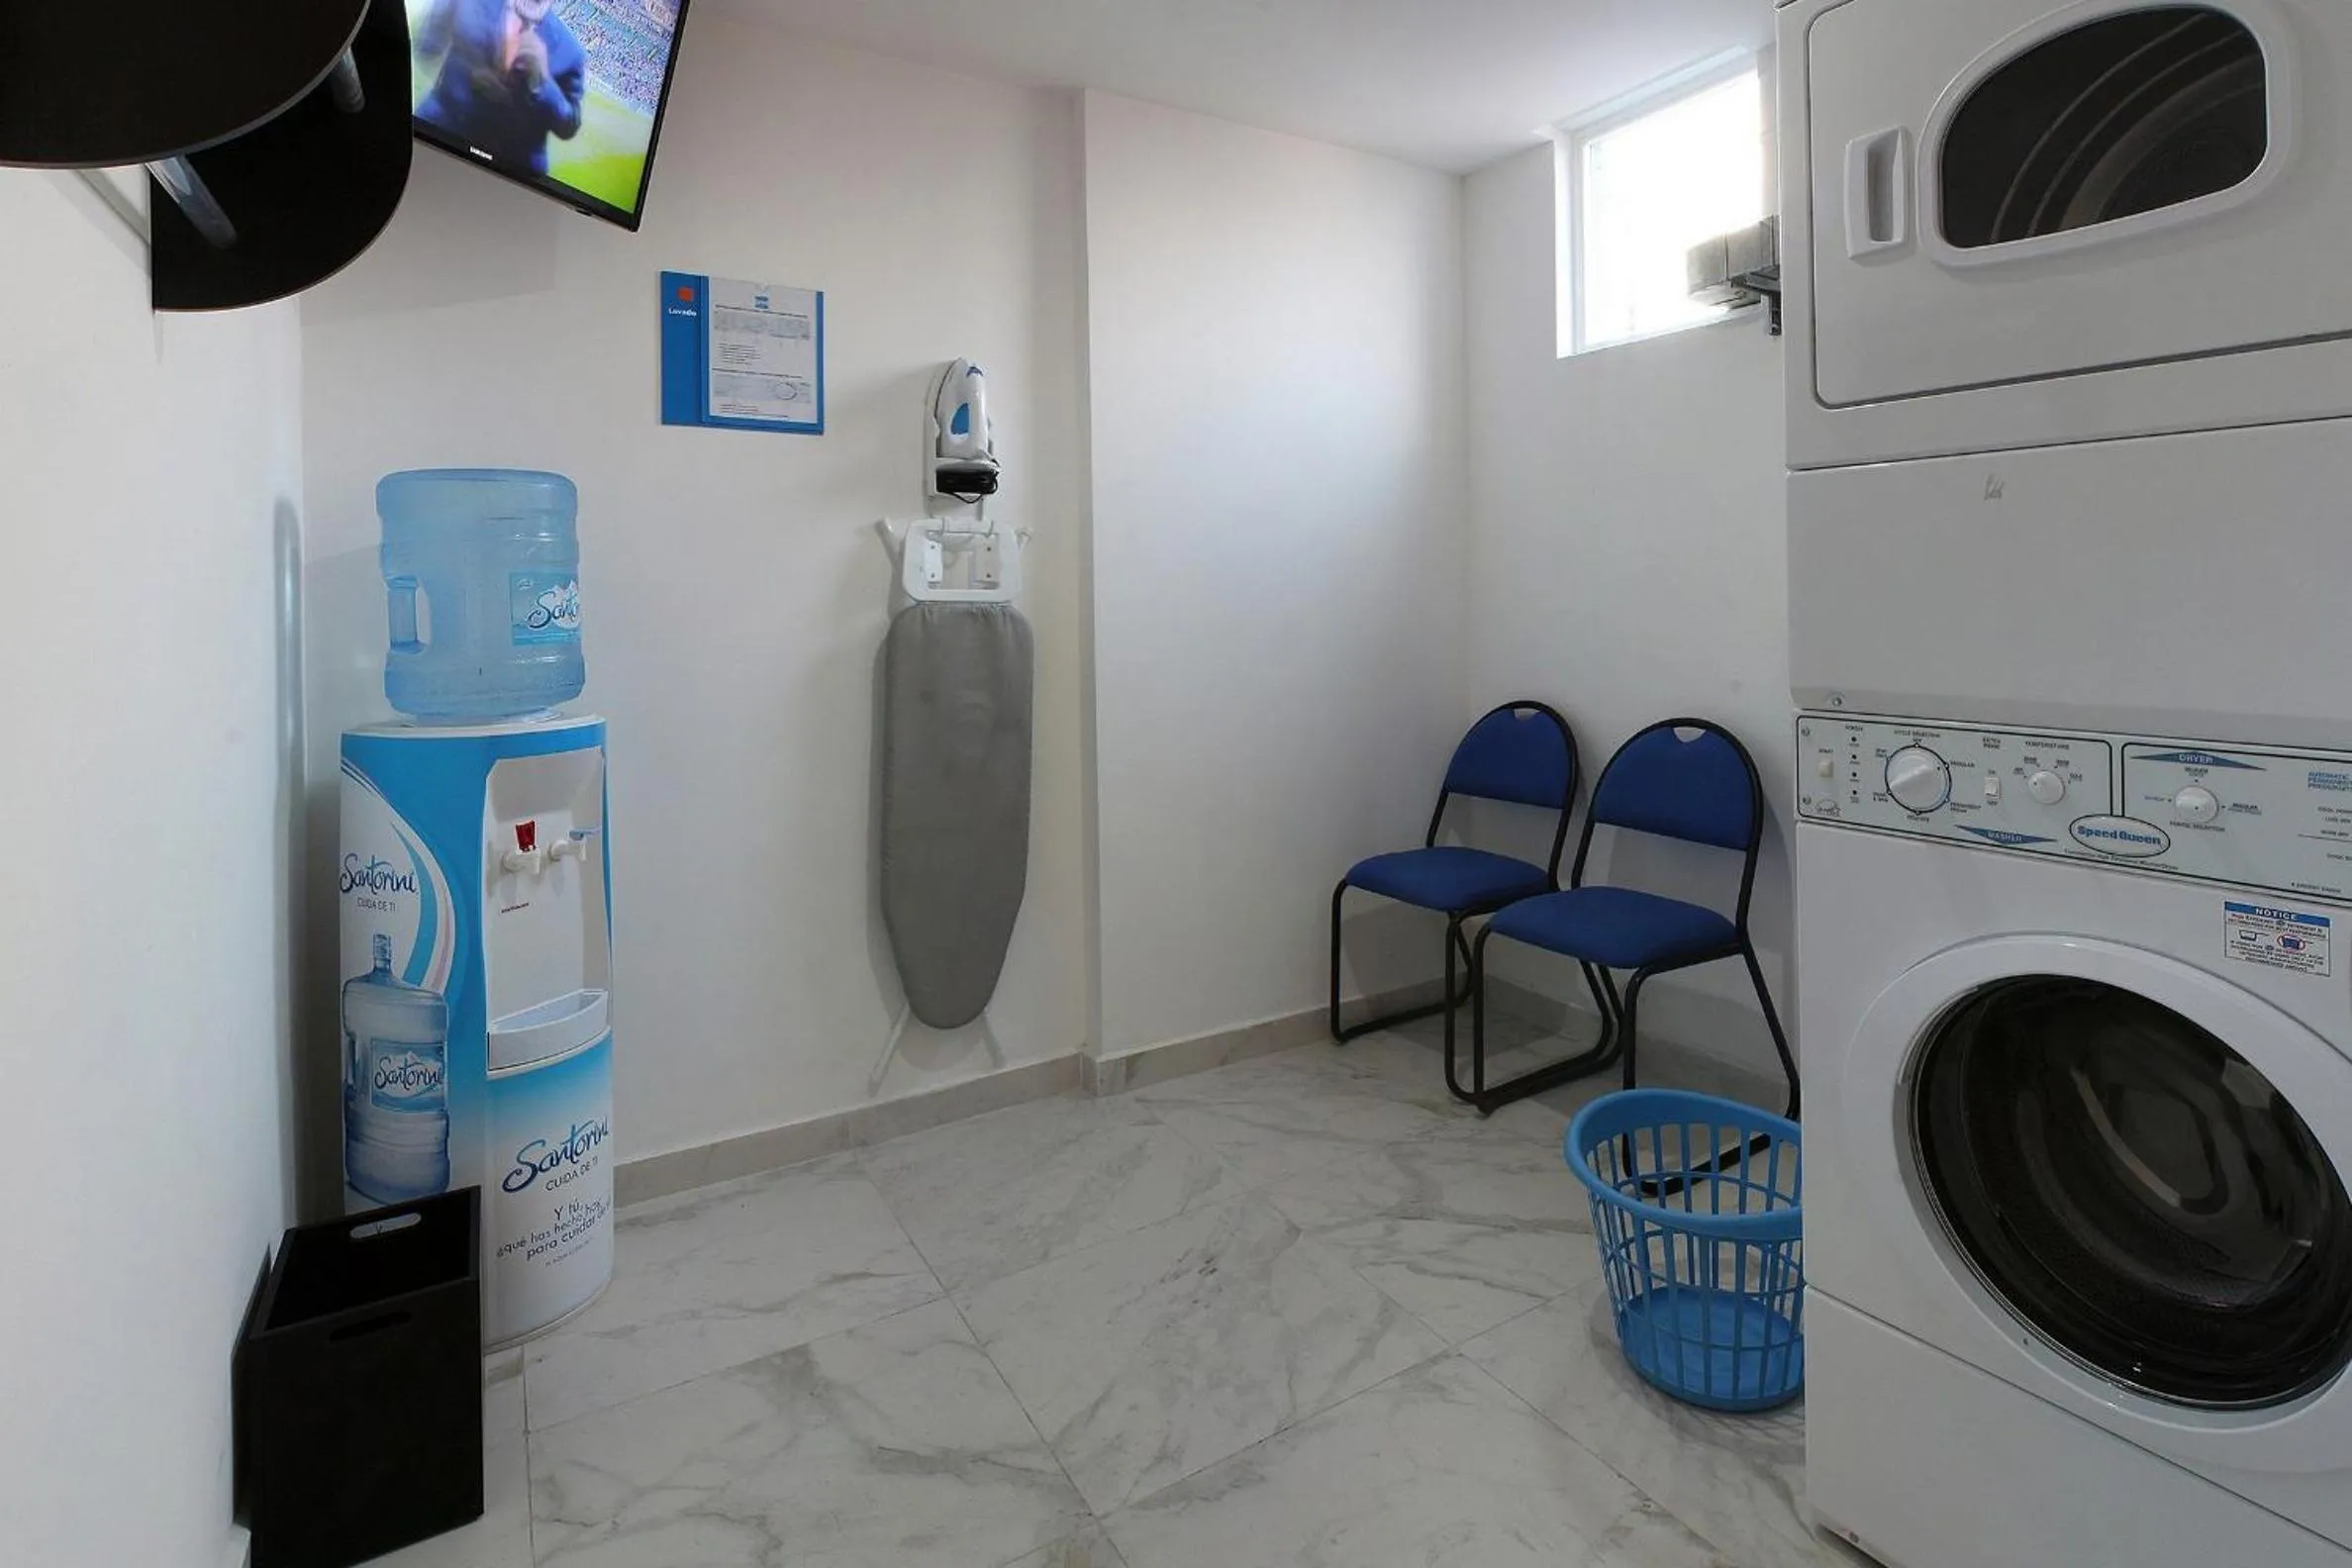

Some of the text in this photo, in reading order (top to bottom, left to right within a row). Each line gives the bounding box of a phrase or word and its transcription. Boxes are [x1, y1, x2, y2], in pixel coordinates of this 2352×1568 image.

[2077, 826, 2162, 845] Speed Queen
[340, 853, 417, 895] Santorini
[2256, 908, 2298, 921] NOTICE
[502, 1117, 609, 1193] Santorini
[554, 1205, 563, 1221] Y
[531, 1230, 550, 1244] has
[527, 1239, 557, 1262] para
